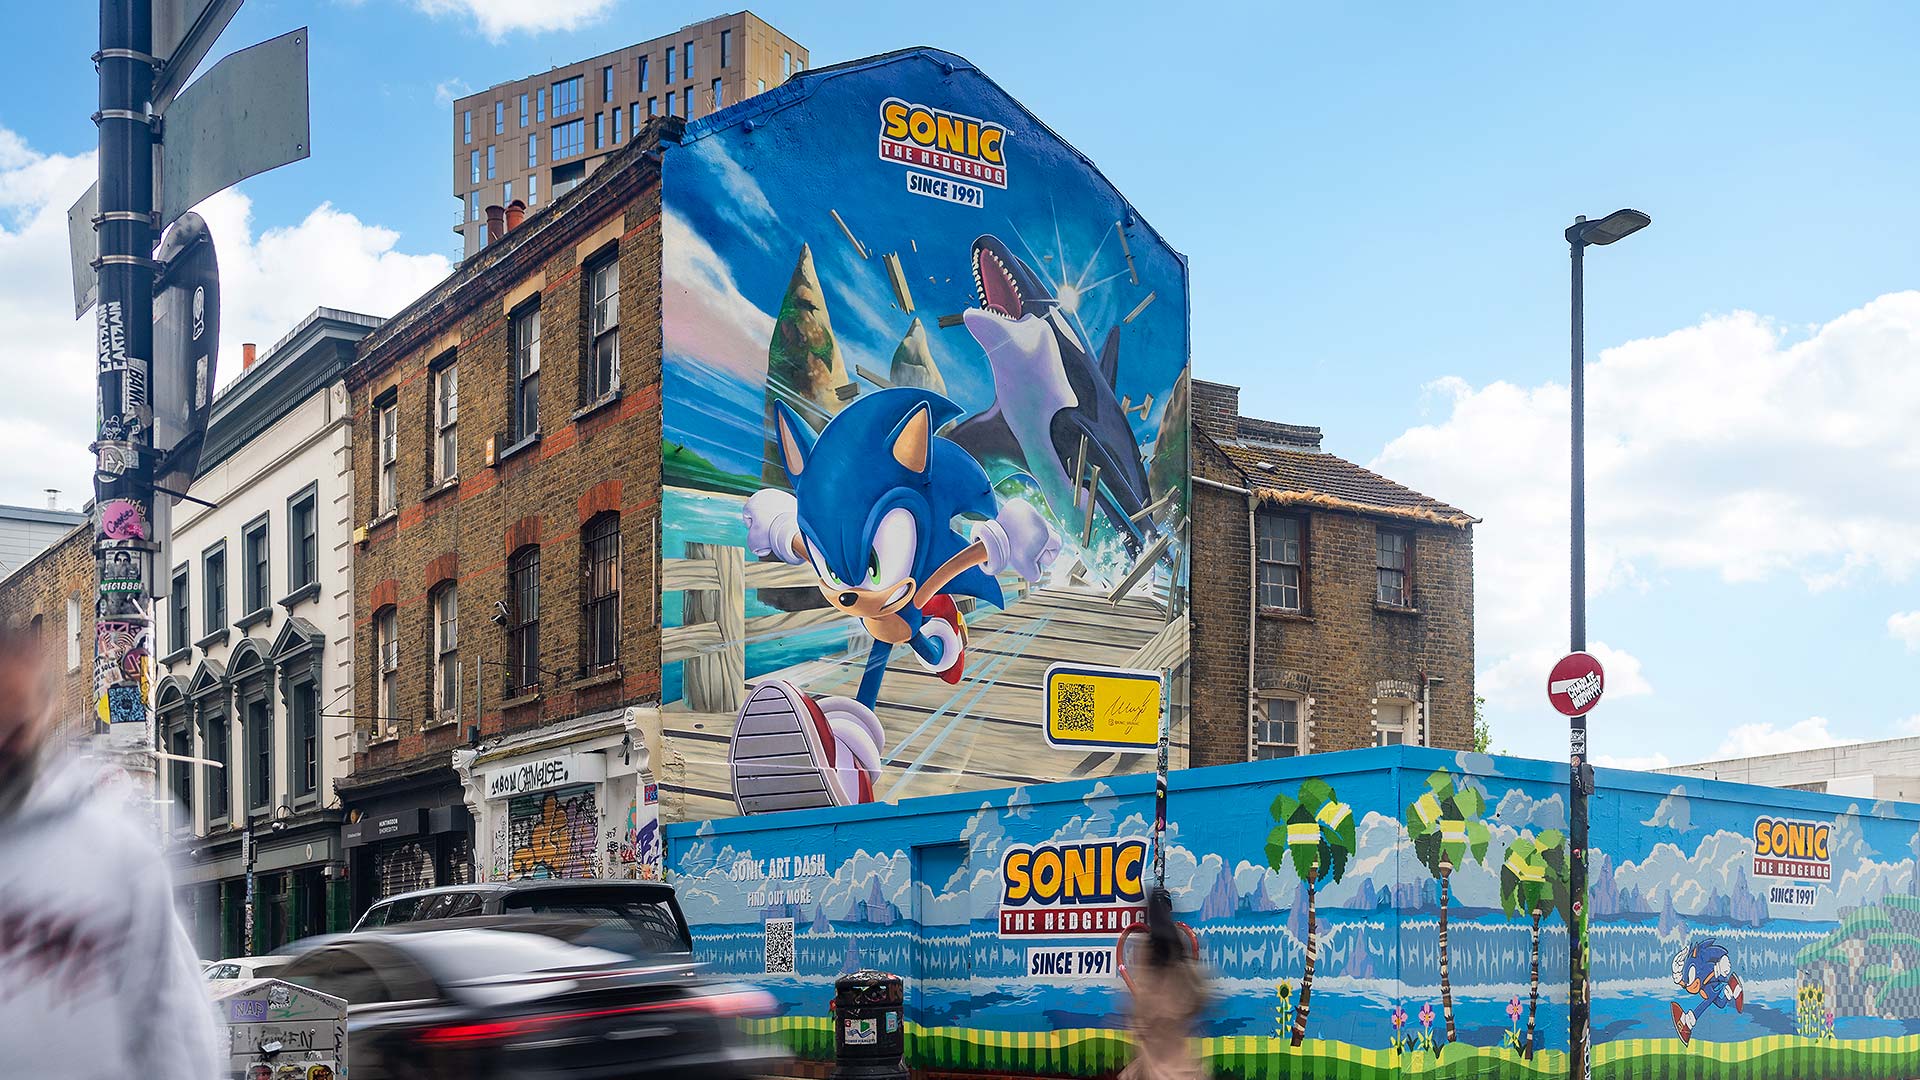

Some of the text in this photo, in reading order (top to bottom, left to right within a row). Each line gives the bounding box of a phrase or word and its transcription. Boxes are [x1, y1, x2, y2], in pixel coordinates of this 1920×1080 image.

[884, 101, 1003, 164] SONIC
[882, 142, 1003, 184] THE HEDGEHOG
[909, 174, 982, 205] SINCE 1991
[1755, 820, 1829, 860] SONIC
[732, 854, 826, 882] SONIC ART DASH
[1005, 843, 1144, 902] SONIC
[1754, 861, 1830, 879] THE HEDGEHOG
[747, 888, 813, 907] FIND OUT MORE
[1770, 887, 1815, 905] SINCE 1991
[1004, 913, 1035, 931] THE
[1031, 951, 1112, 975] SINCE 1991
